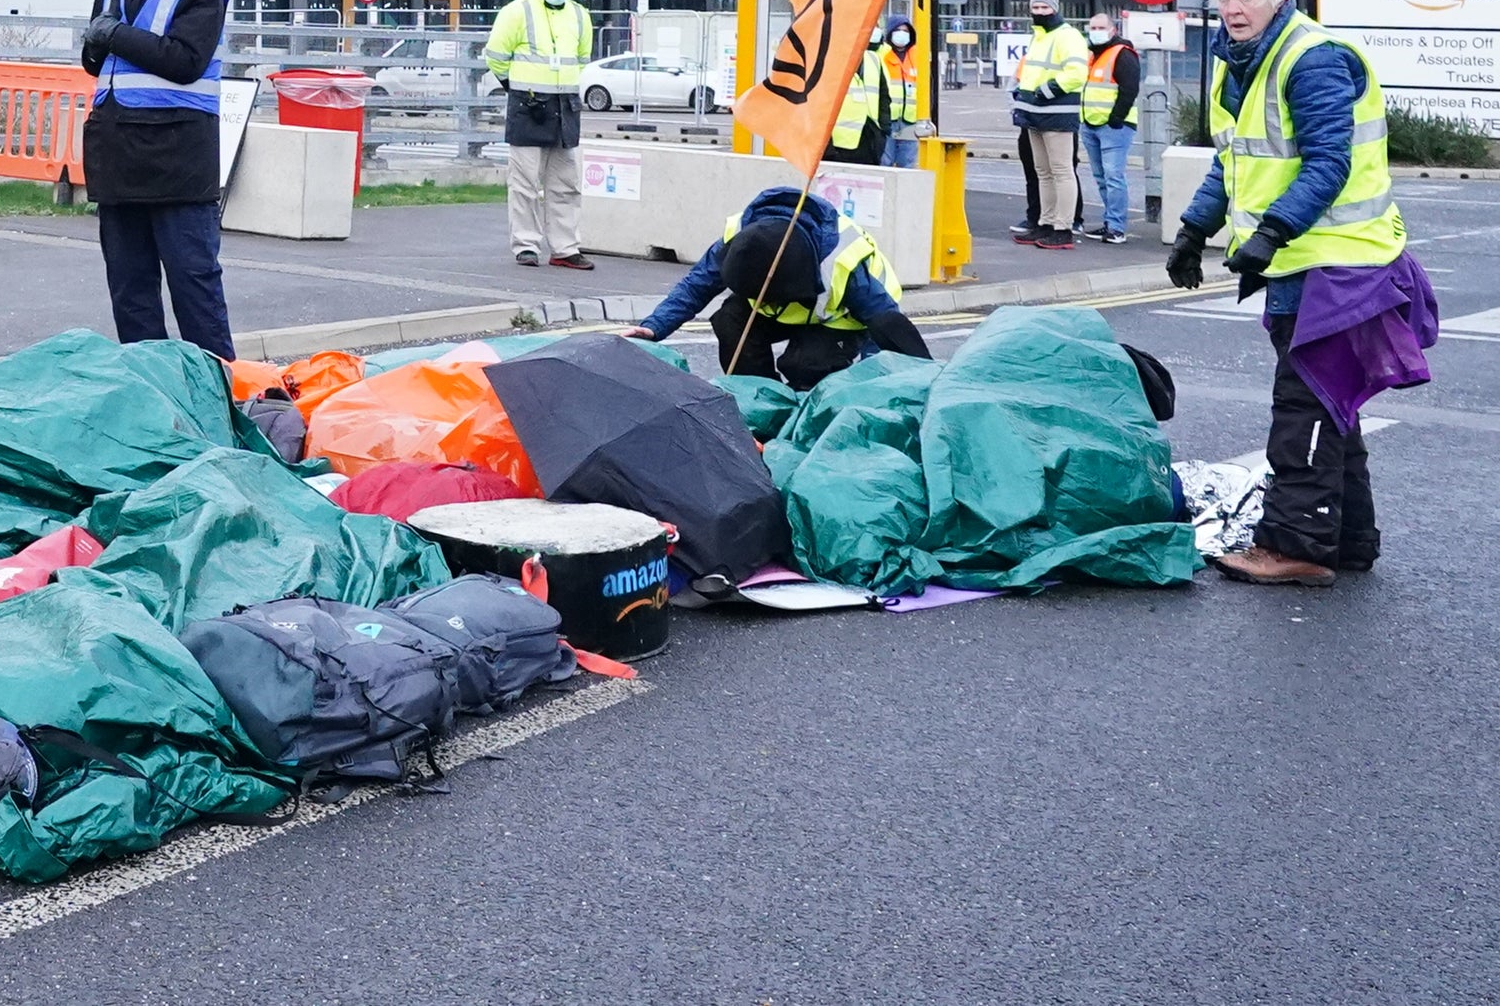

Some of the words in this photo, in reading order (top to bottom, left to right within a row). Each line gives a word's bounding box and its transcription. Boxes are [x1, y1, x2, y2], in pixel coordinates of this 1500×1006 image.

[1362, 34, 1414, 47] Visitors
[1418, 36, 1428, 48] &
[1433, 36, 1468, 51] Drop
[1472, 37, 1494, 49] Off
[1416, 53, 1495, 67] Associates
[1445, 70, 1495, 84] Trucks
[1385, 94, 1467, 109] Winchelsea
[602, 554, 668, 598] amazon
